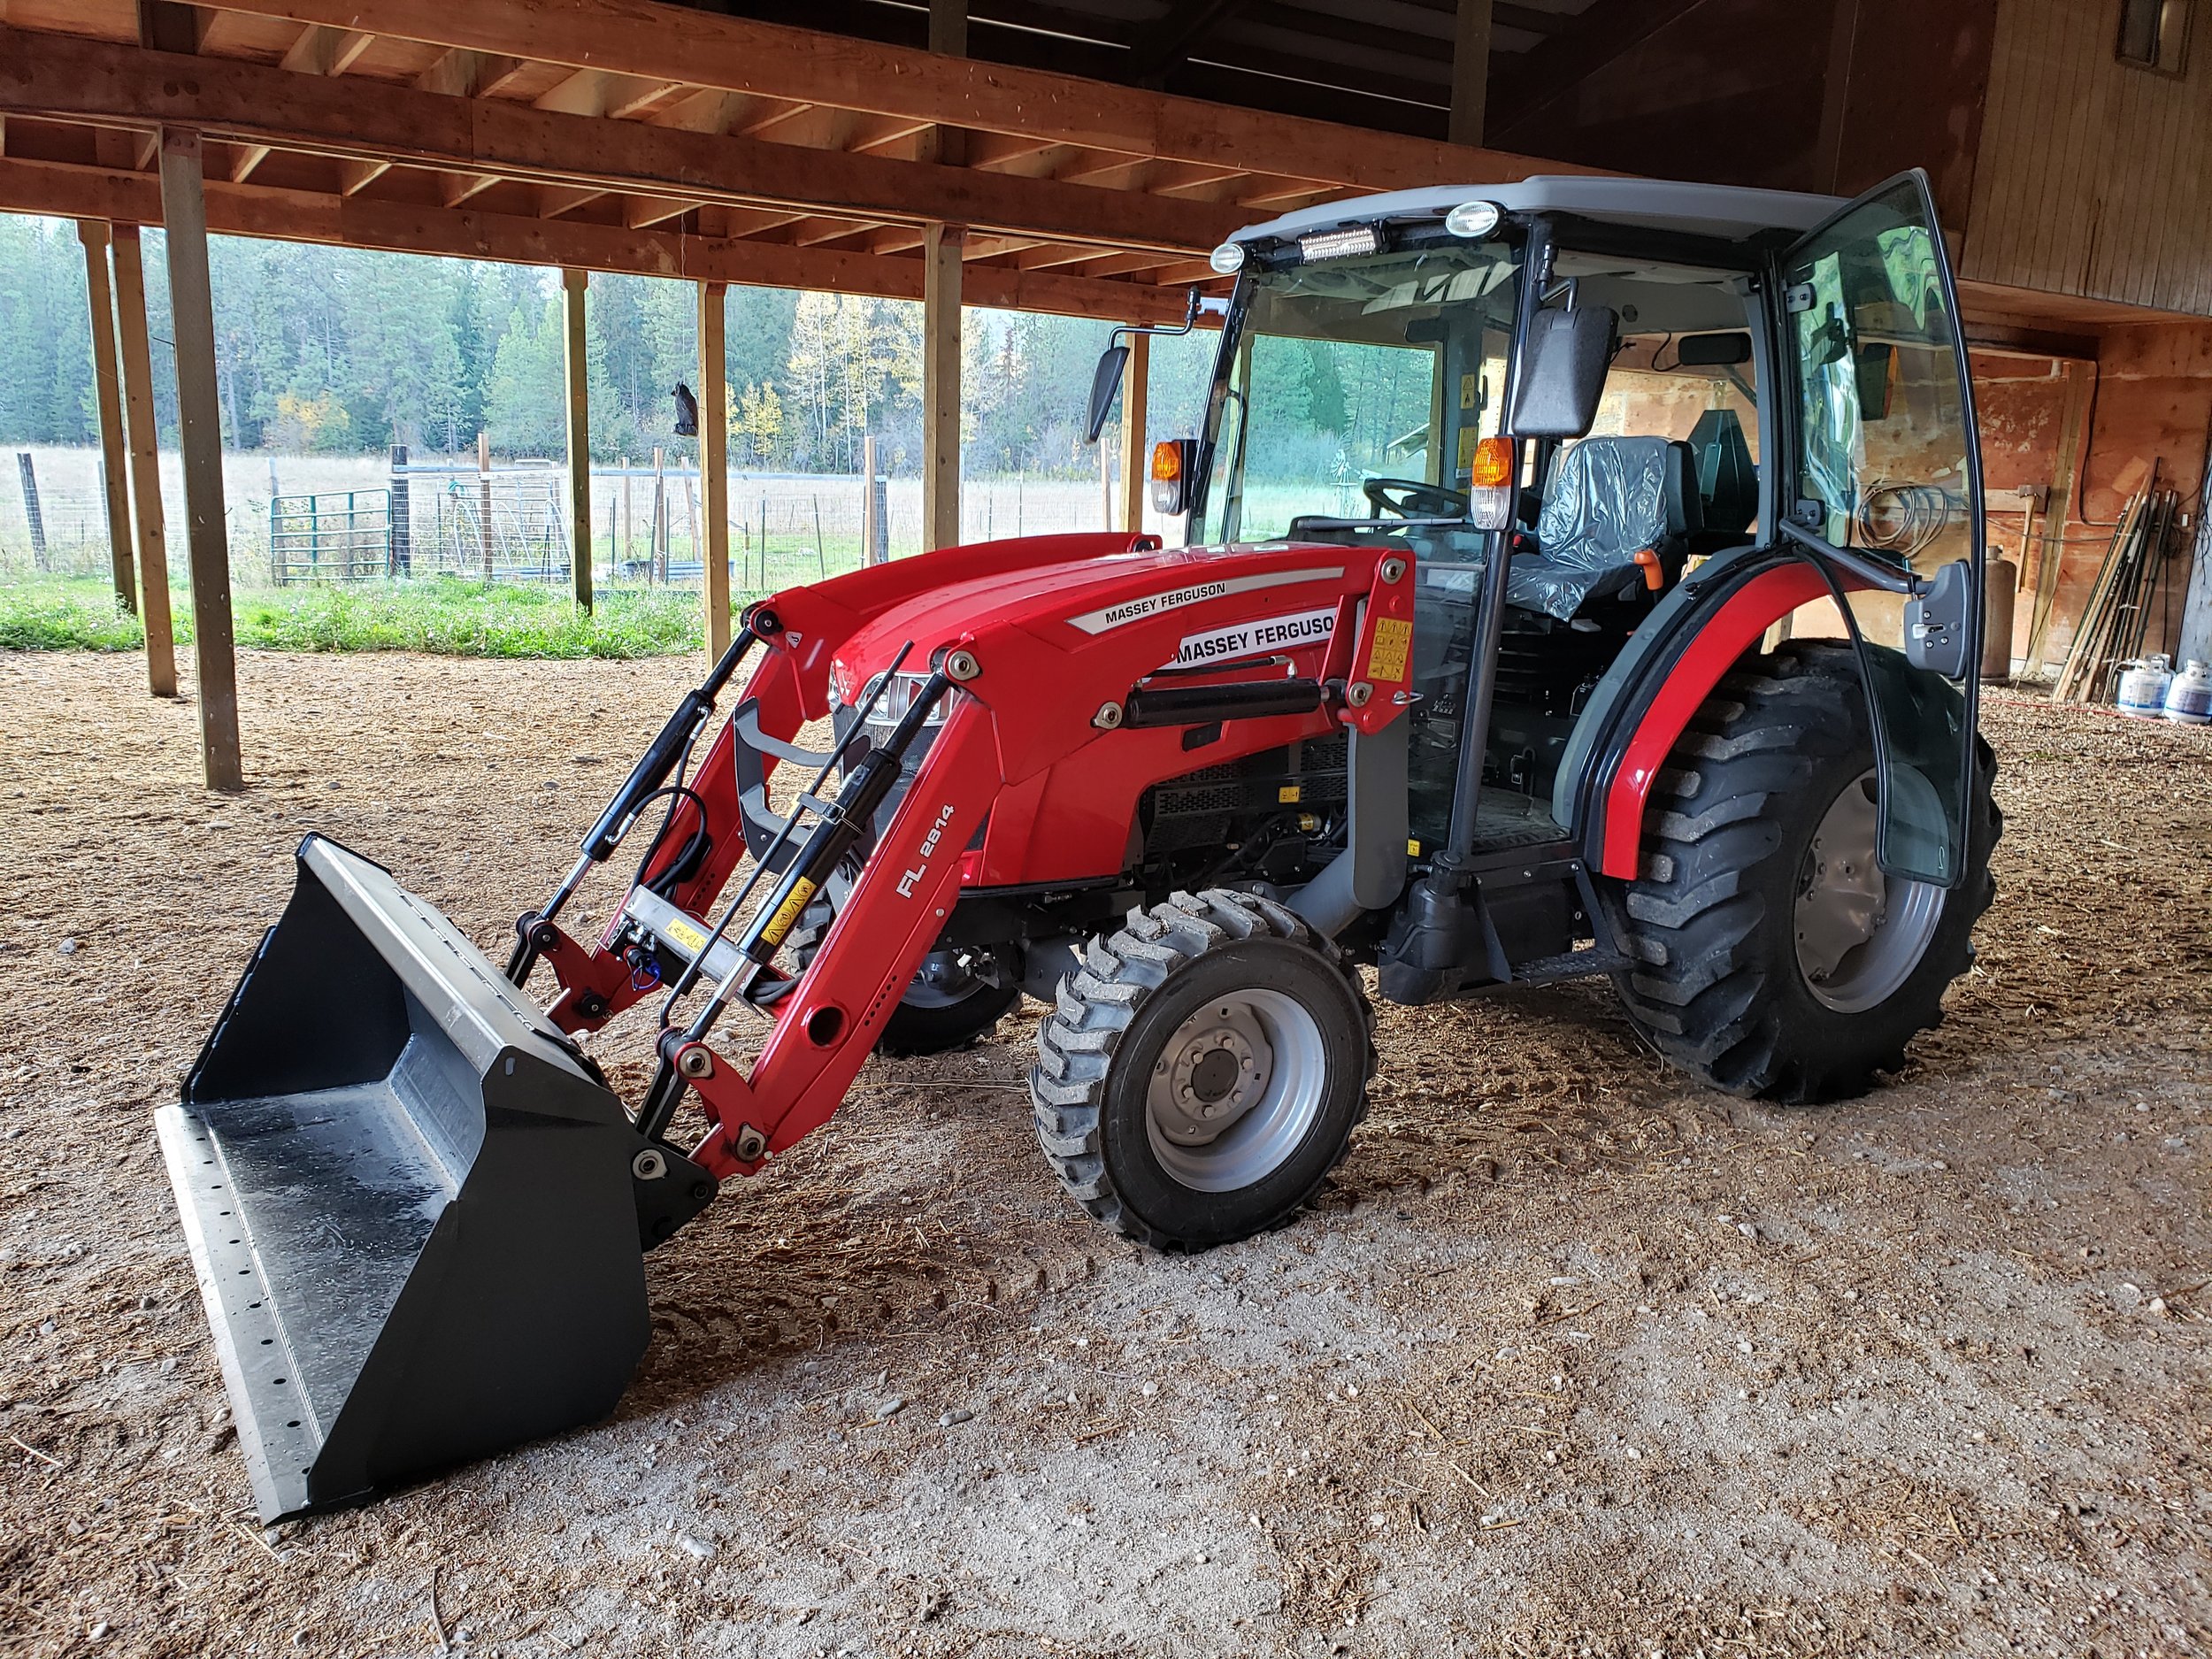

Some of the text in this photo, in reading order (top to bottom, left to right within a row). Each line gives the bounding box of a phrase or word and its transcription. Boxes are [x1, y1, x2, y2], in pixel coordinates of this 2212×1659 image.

[1105, 582, 1225, 624] MASSEY FERGUSON
[1177, 615, 1336, 664] MASSEY FERGUSO
[896, 804, 955, 899] FL 2814
